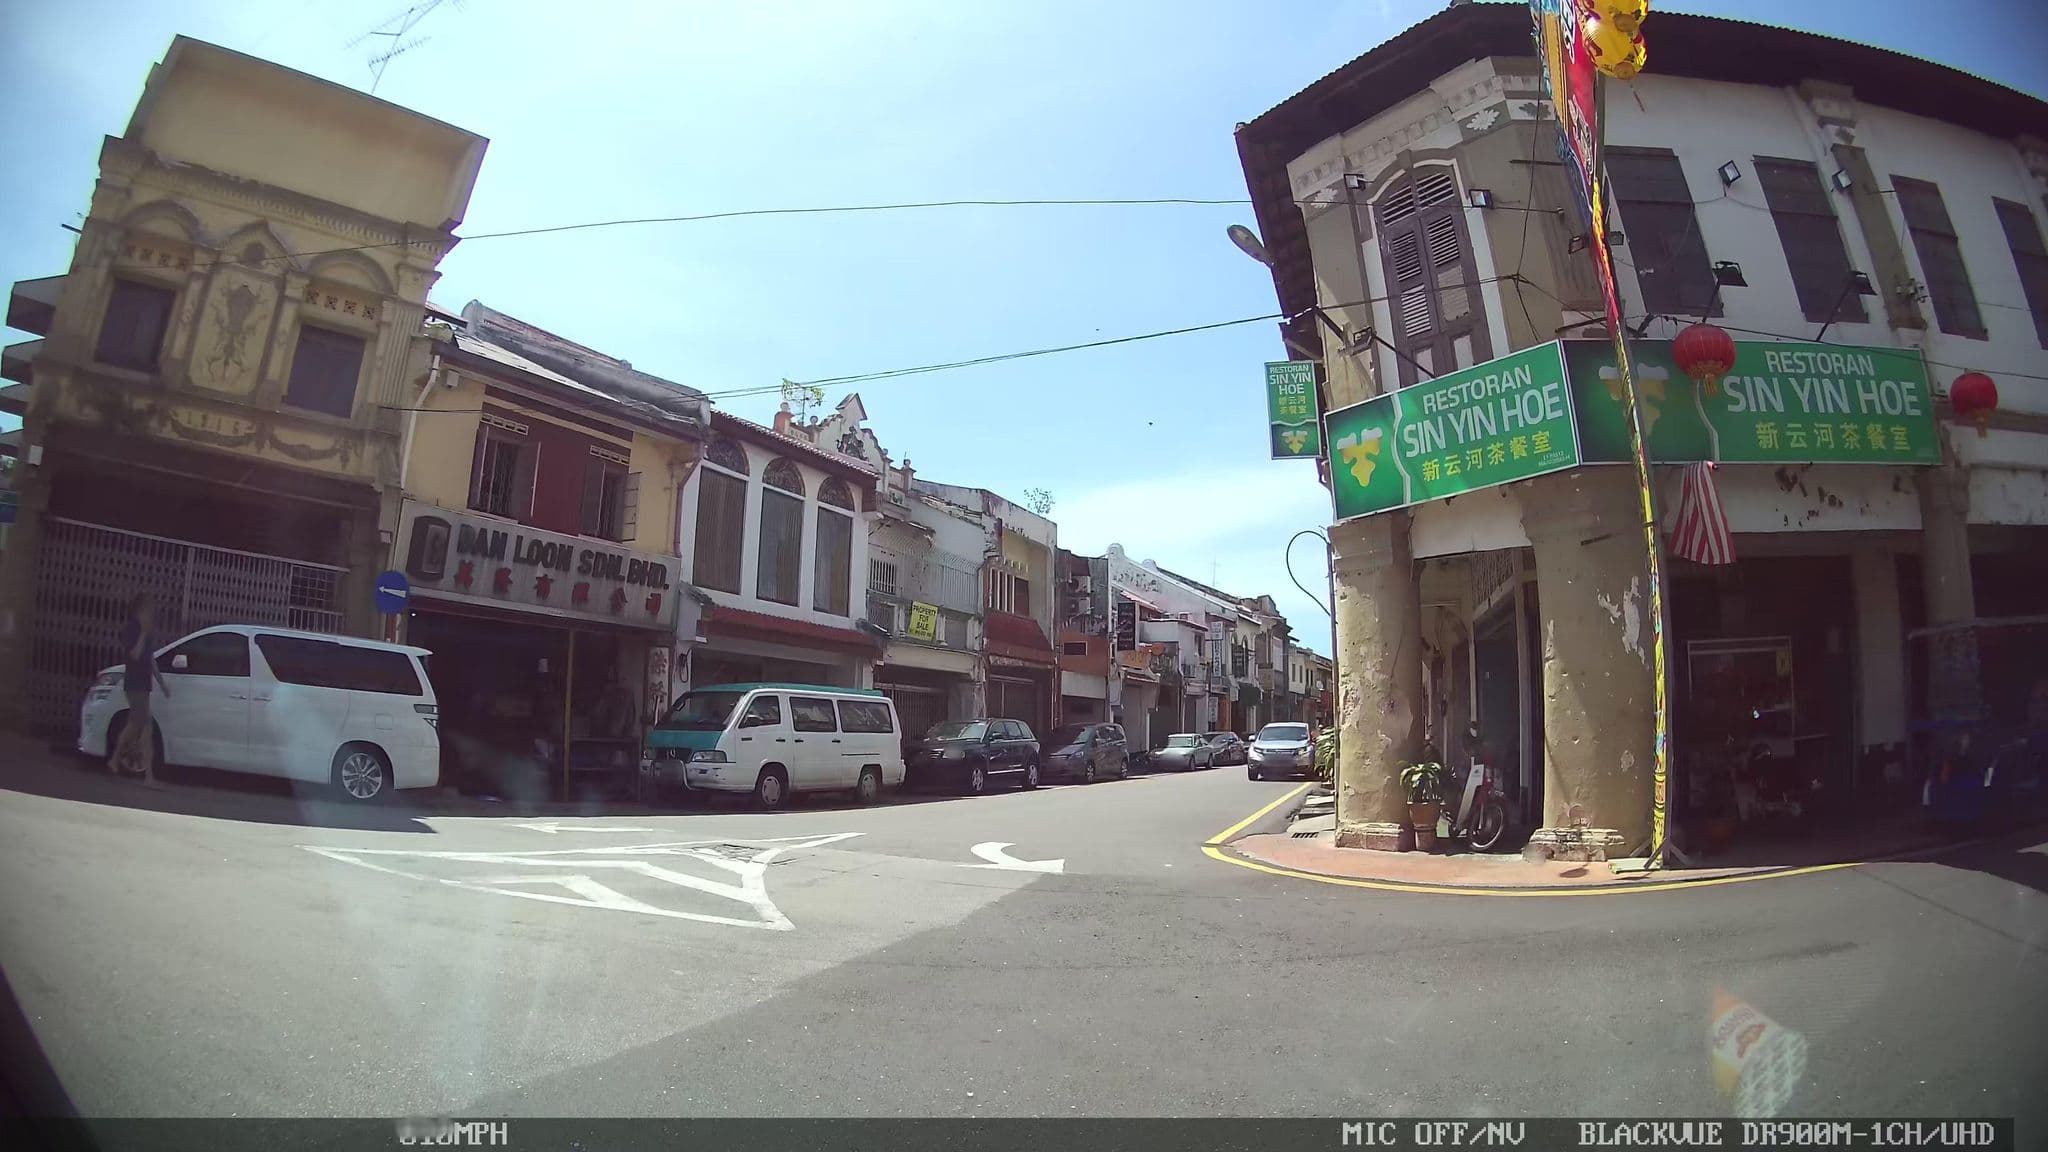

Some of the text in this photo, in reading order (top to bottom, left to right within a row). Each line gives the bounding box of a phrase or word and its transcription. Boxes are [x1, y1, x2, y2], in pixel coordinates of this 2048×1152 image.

[1269, 365, 1309, 374] RESTORAN
[1765, 351, 1875, 376] RESTORAN
[1269, 372, 1312, 385] SIN YIN
[1279, 383, 1305, 395] HOE
[1423, 364, 1532, 414] RESTORAN
[1722, 375, 1922, 416] SIN YIN HOE
[1403, 383, 1564, 459] SIN YIN HOE
[1755, 421, 1911, 451] 新云河茶餐室
[1422, 430, 1552, 482] 新云河茶餐室
[513, 535, 574, 572] LOON
[626, 557, 670, 590] BHD.
[916, 621, 929, 631] SALE
[918, 614, 929, 622] FOR
